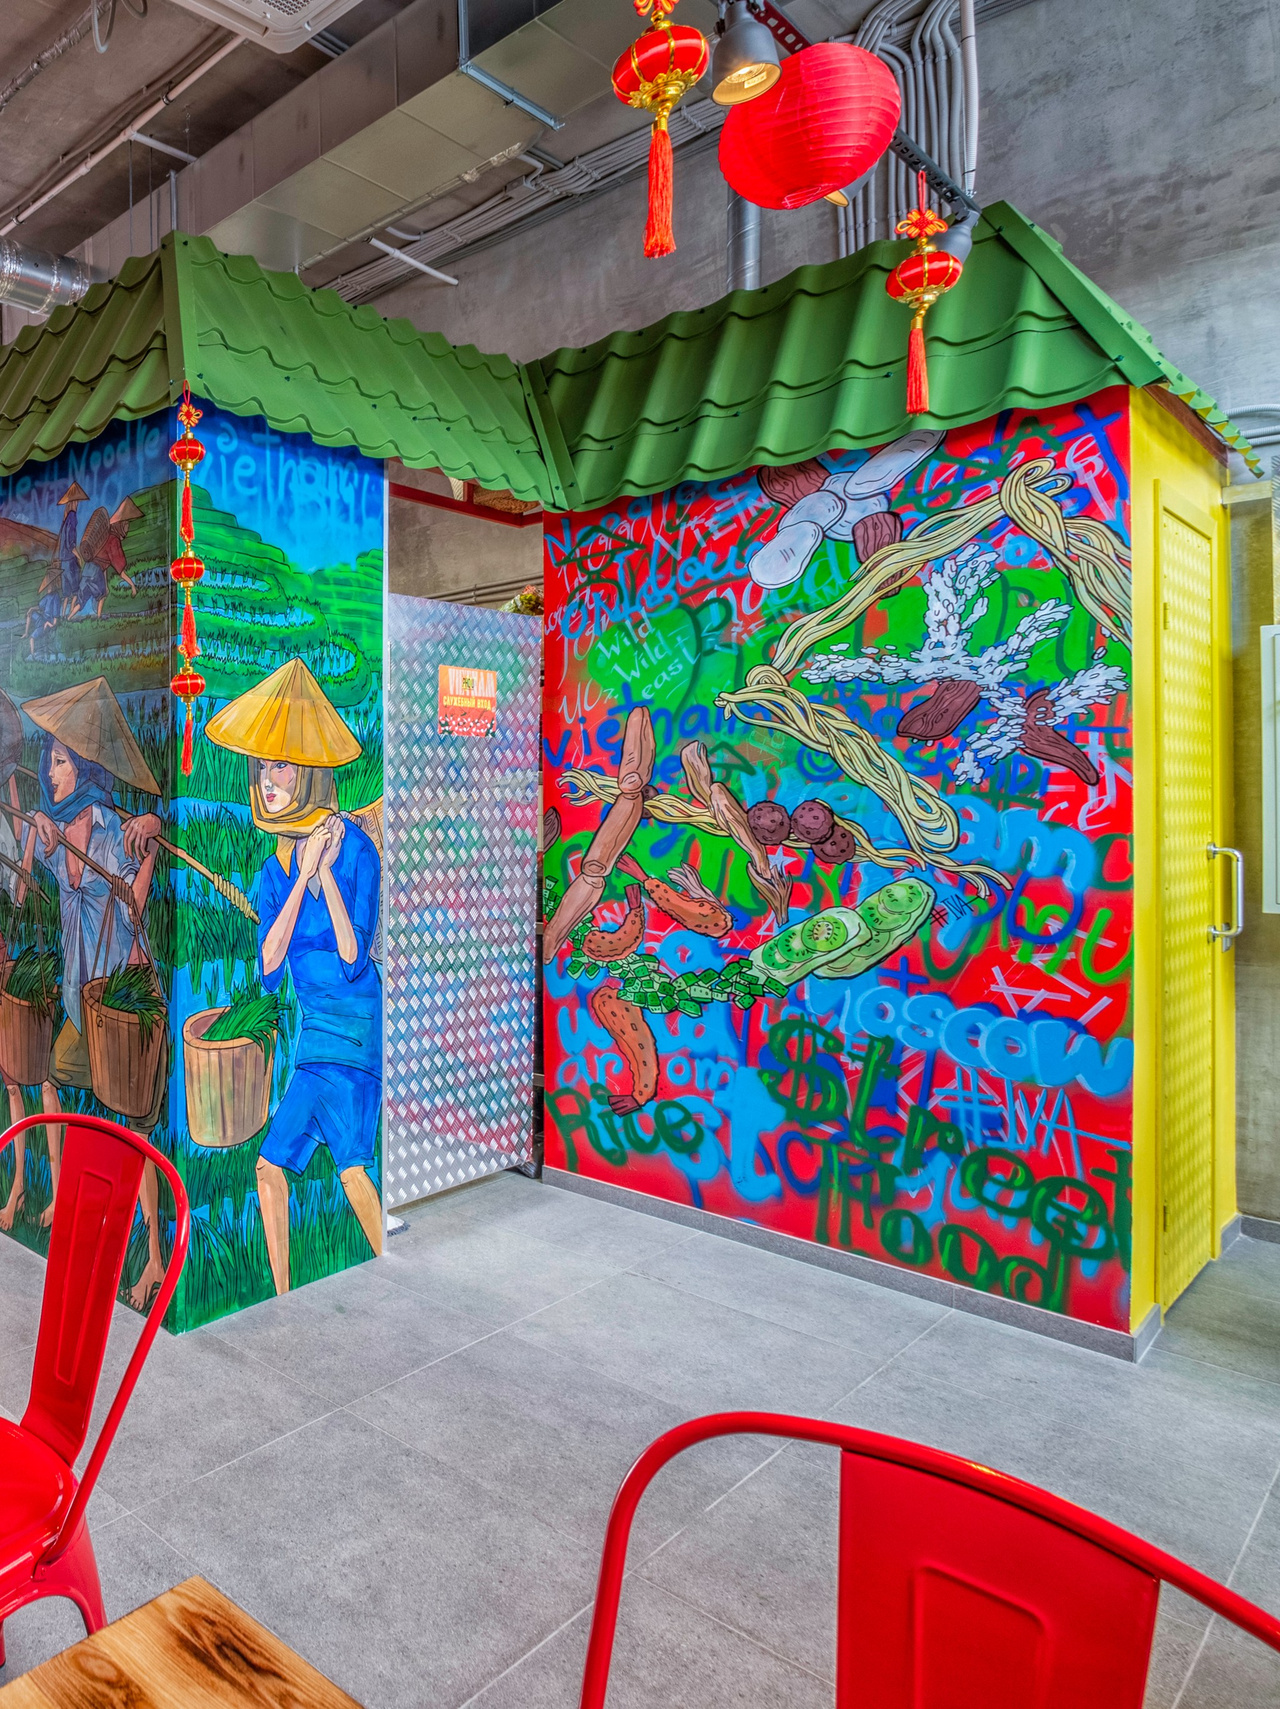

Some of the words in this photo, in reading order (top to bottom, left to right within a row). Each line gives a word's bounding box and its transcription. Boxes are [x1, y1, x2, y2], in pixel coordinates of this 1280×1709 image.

[596, 606, 658, 660] Wild
[612, 629, 671, 683] Wild
[641, 634, 702, 699] east
[443, 696, 476, 708] СЛУЖЕБНЫЙ
[477, 699, 491, 711] ВХОД
[929, 893, 978, 929] #IVA
[544, 1083, 705, 1173] Rice
